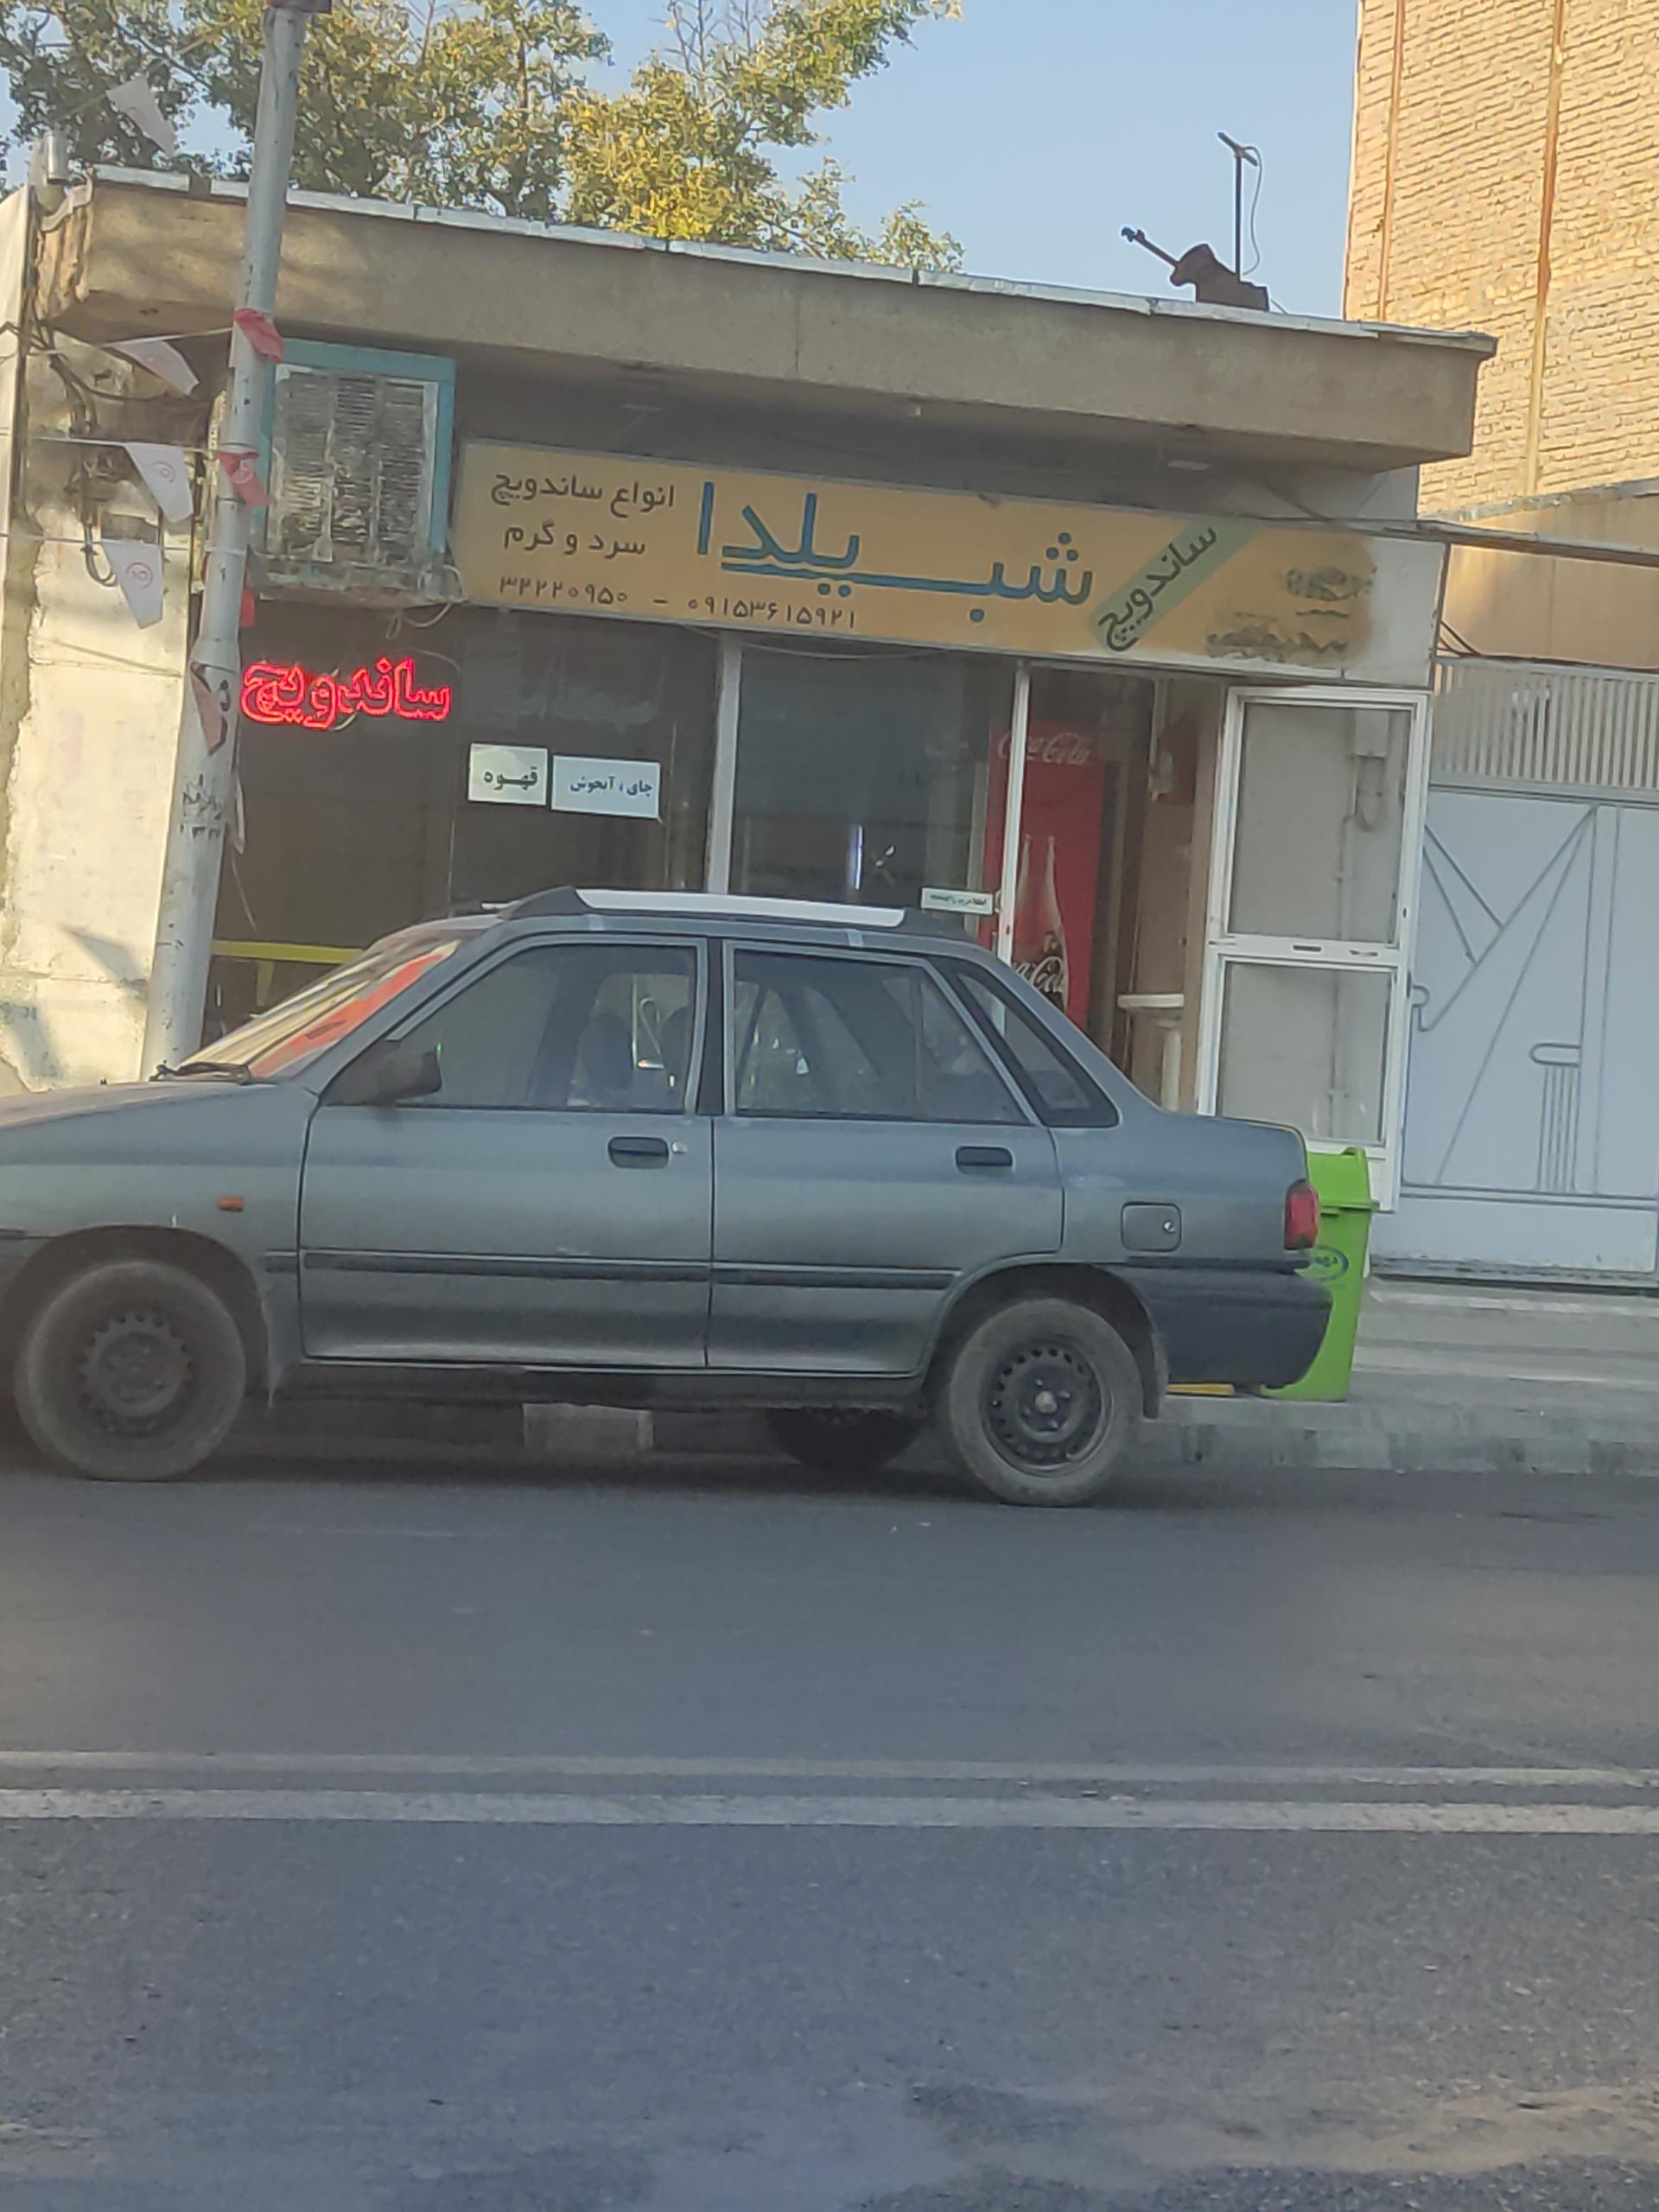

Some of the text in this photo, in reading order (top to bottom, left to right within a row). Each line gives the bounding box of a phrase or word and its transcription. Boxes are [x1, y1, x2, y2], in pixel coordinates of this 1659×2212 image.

[491, 474, 674, 518] انواع ساندویچ
[504, 519, 646, 560] سرد و گرم
[696, 481, 1093, 623] شب یلدا
[1097, 526, 1217, 652] ساندویچ
[241, 656, 450, 729] ساندویچ
[483, 766, 538, 791] قهوه
